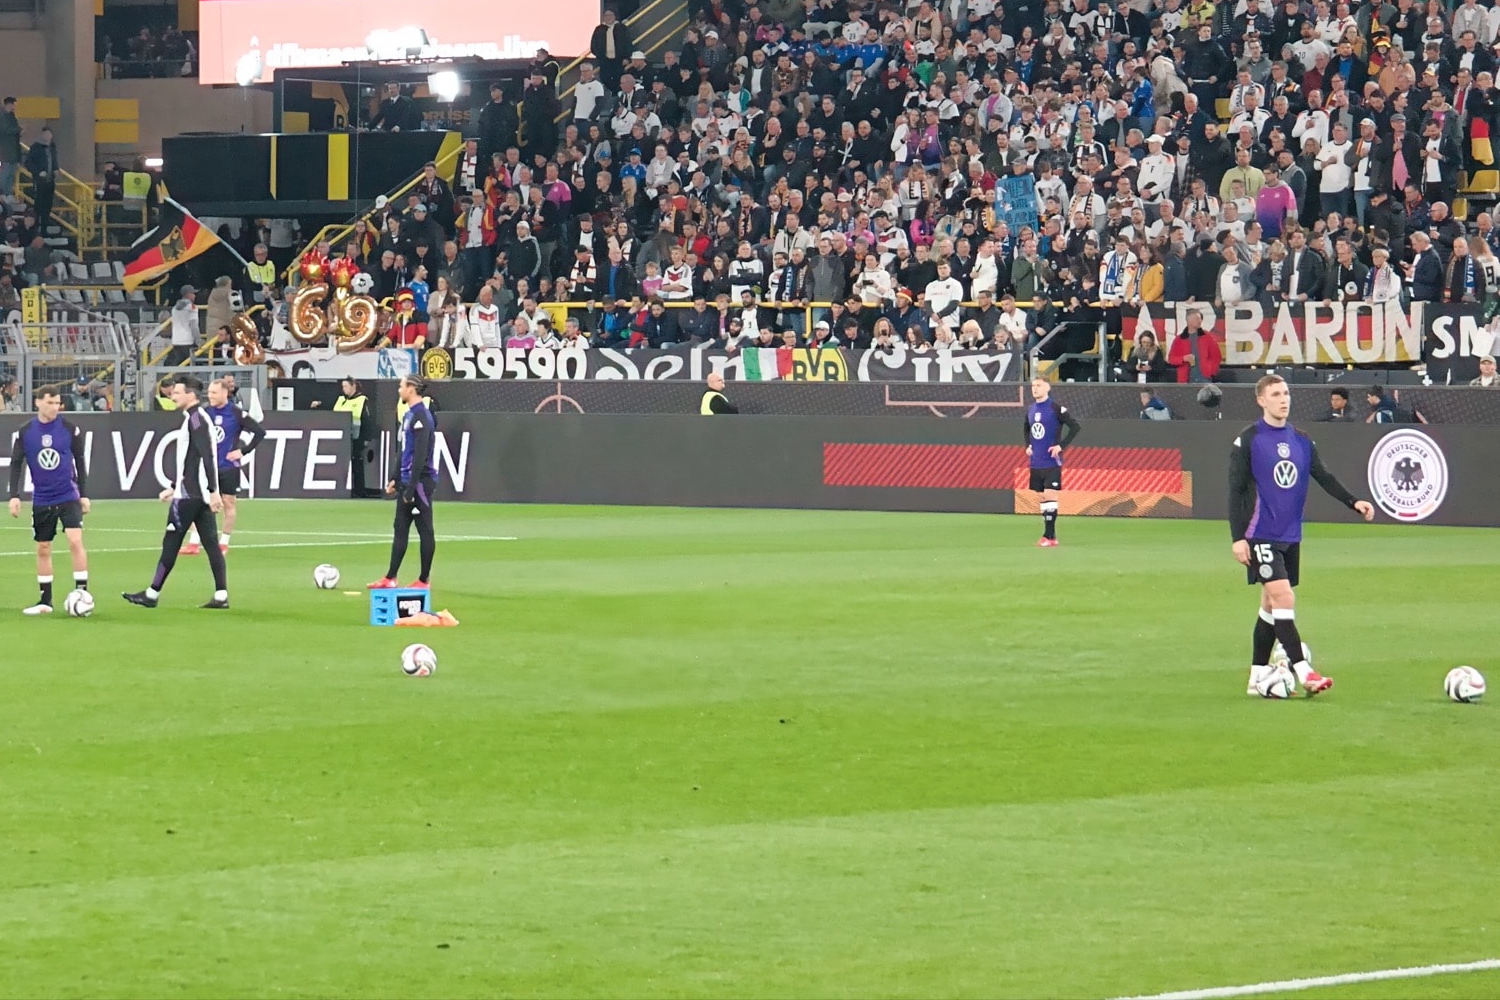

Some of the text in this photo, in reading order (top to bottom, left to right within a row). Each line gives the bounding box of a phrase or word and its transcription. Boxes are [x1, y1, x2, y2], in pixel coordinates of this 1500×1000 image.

[454, 348, 587, 380] 59590
[791, 350, 839, 381] BVB
[37, 447, 60, 470] VW
[1386, 443, 1429, 459] DEUTSCHER
[1273, 459, 1298, 489] VW
[1254, 543, 1274, 564] 15
